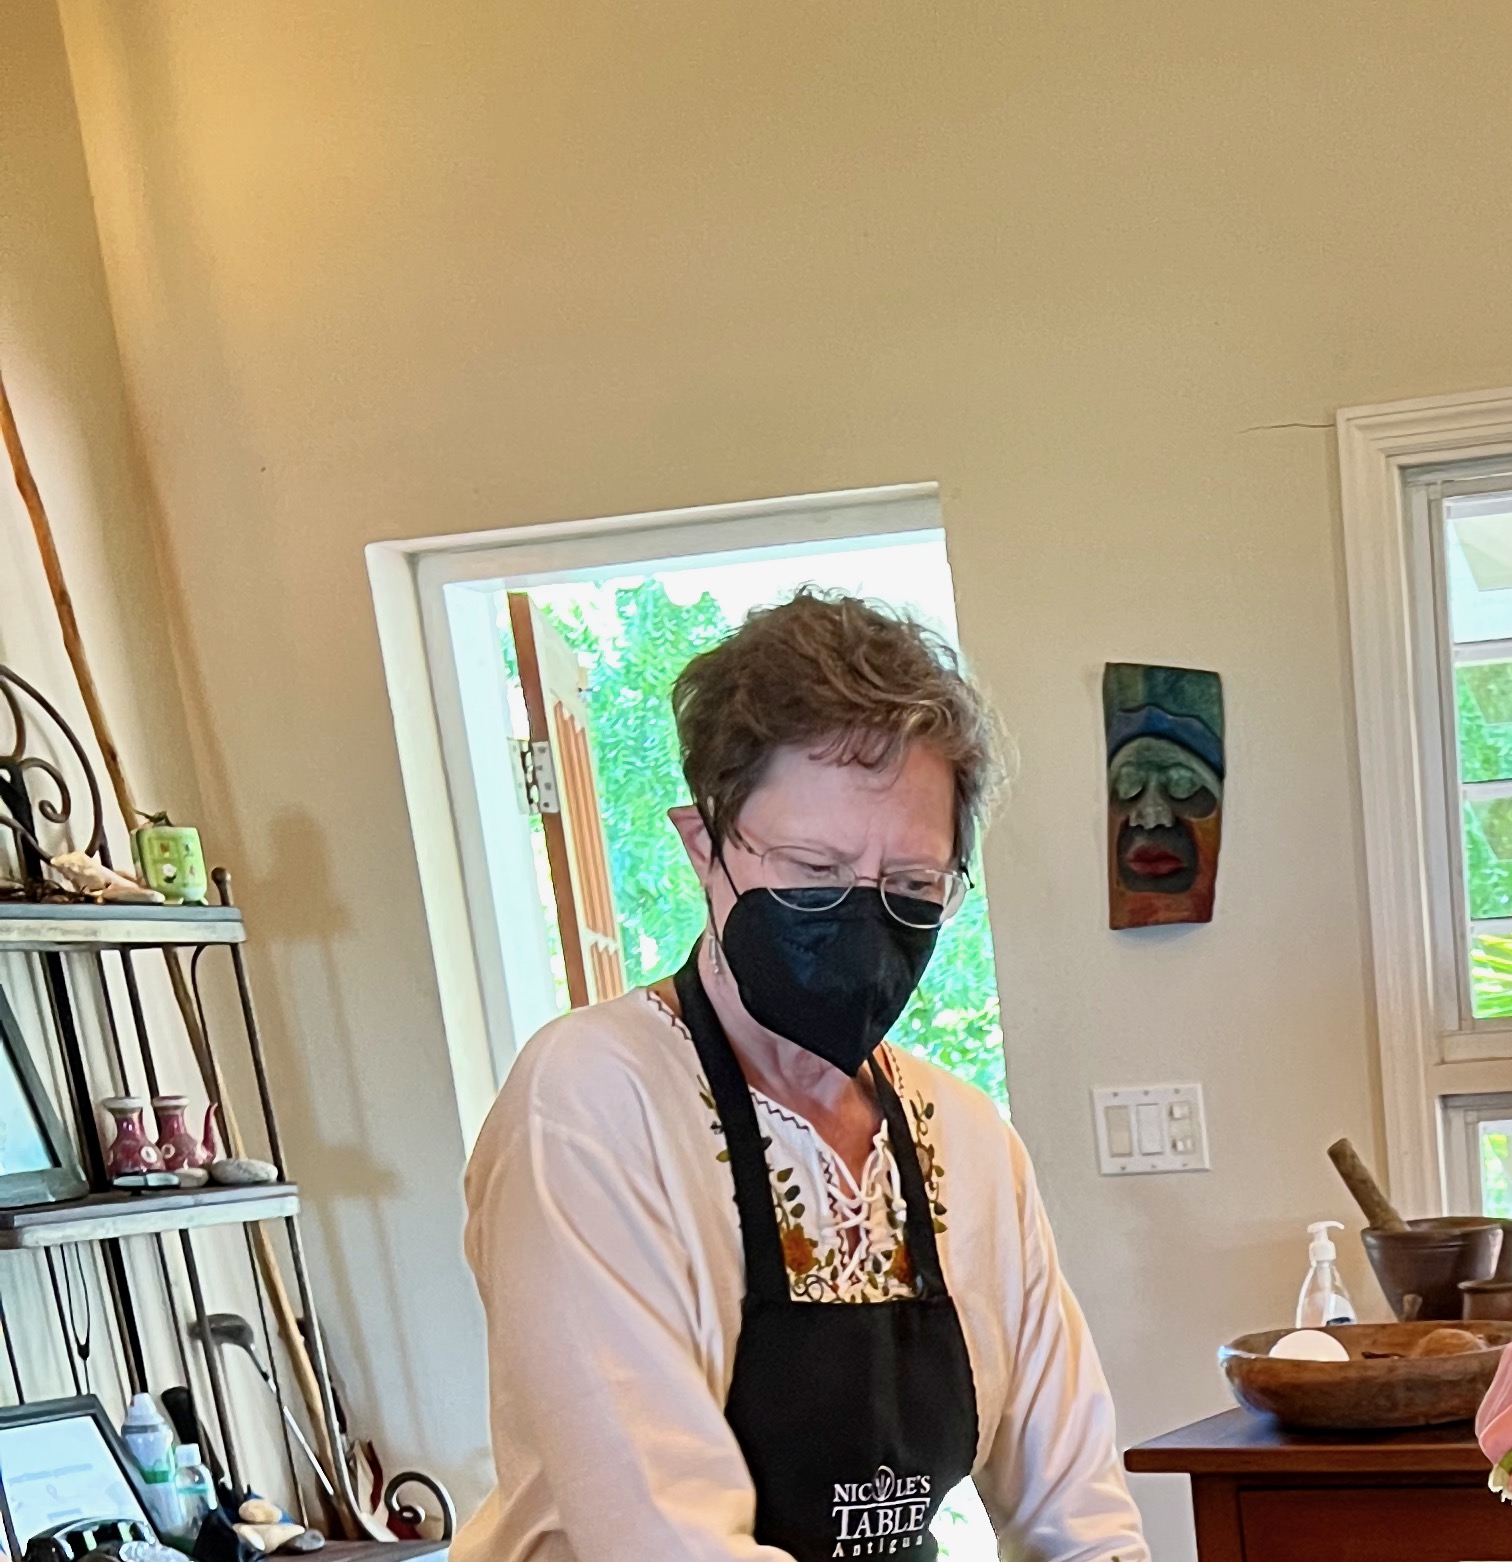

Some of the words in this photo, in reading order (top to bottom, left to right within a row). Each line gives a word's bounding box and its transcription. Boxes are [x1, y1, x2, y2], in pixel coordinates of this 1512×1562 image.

[833, 1465, 931, 1503] NICOLE'S
[832, 1498, 930, 1540] TABLE
[832, 1535, 923, 1558] Antigua
